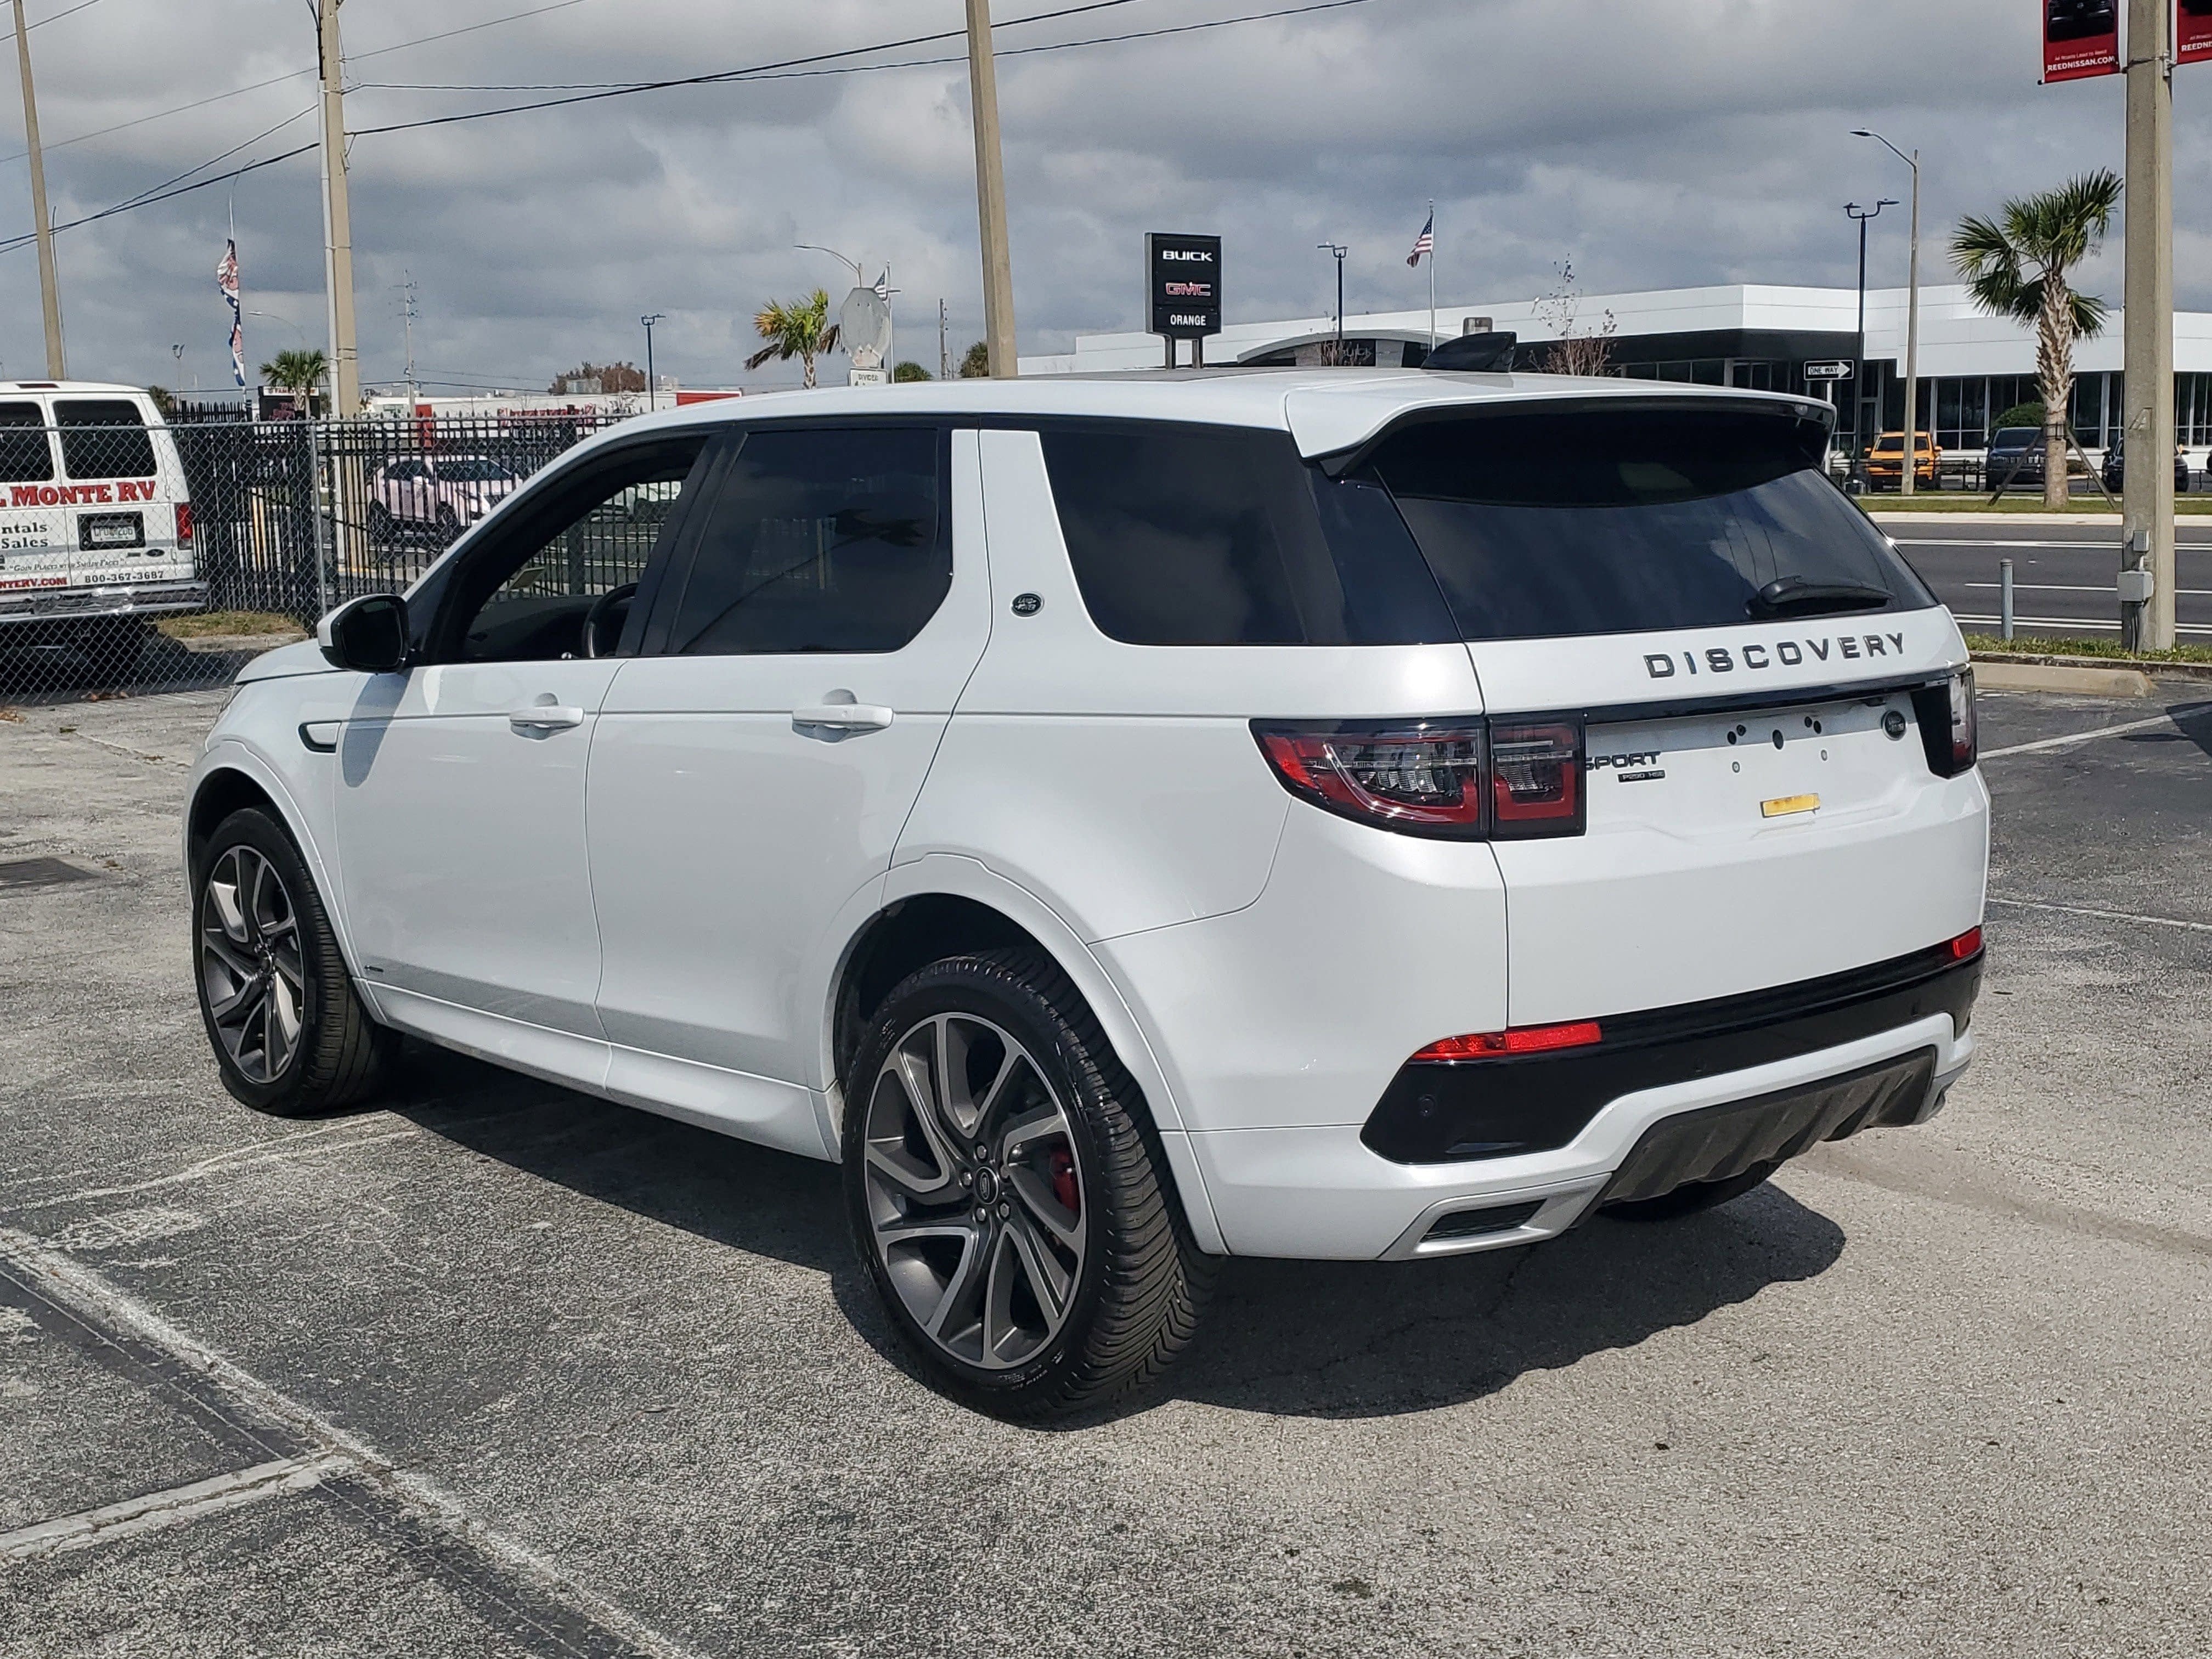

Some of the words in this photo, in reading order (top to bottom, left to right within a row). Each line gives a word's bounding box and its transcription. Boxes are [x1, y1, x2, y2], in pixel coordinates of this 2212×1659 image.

[2047, 55, 2115, 71] REEDNISSAN.COM
[1163, 250, 1213, 262] BUICK
[1166, 282, 1211, 296] GMC
[1170, 314, 1206, 326] ORANGE
[10, 484, 112, 506] MONTE
[116, 481, 156, 501] RV
[1, 522, 48, 534] ntals
[1, 537, 49, 549] Sales
[85, 571, 164, 583] 800-367-3687
[1643, 633, 1903, 678] DISCOVERY
